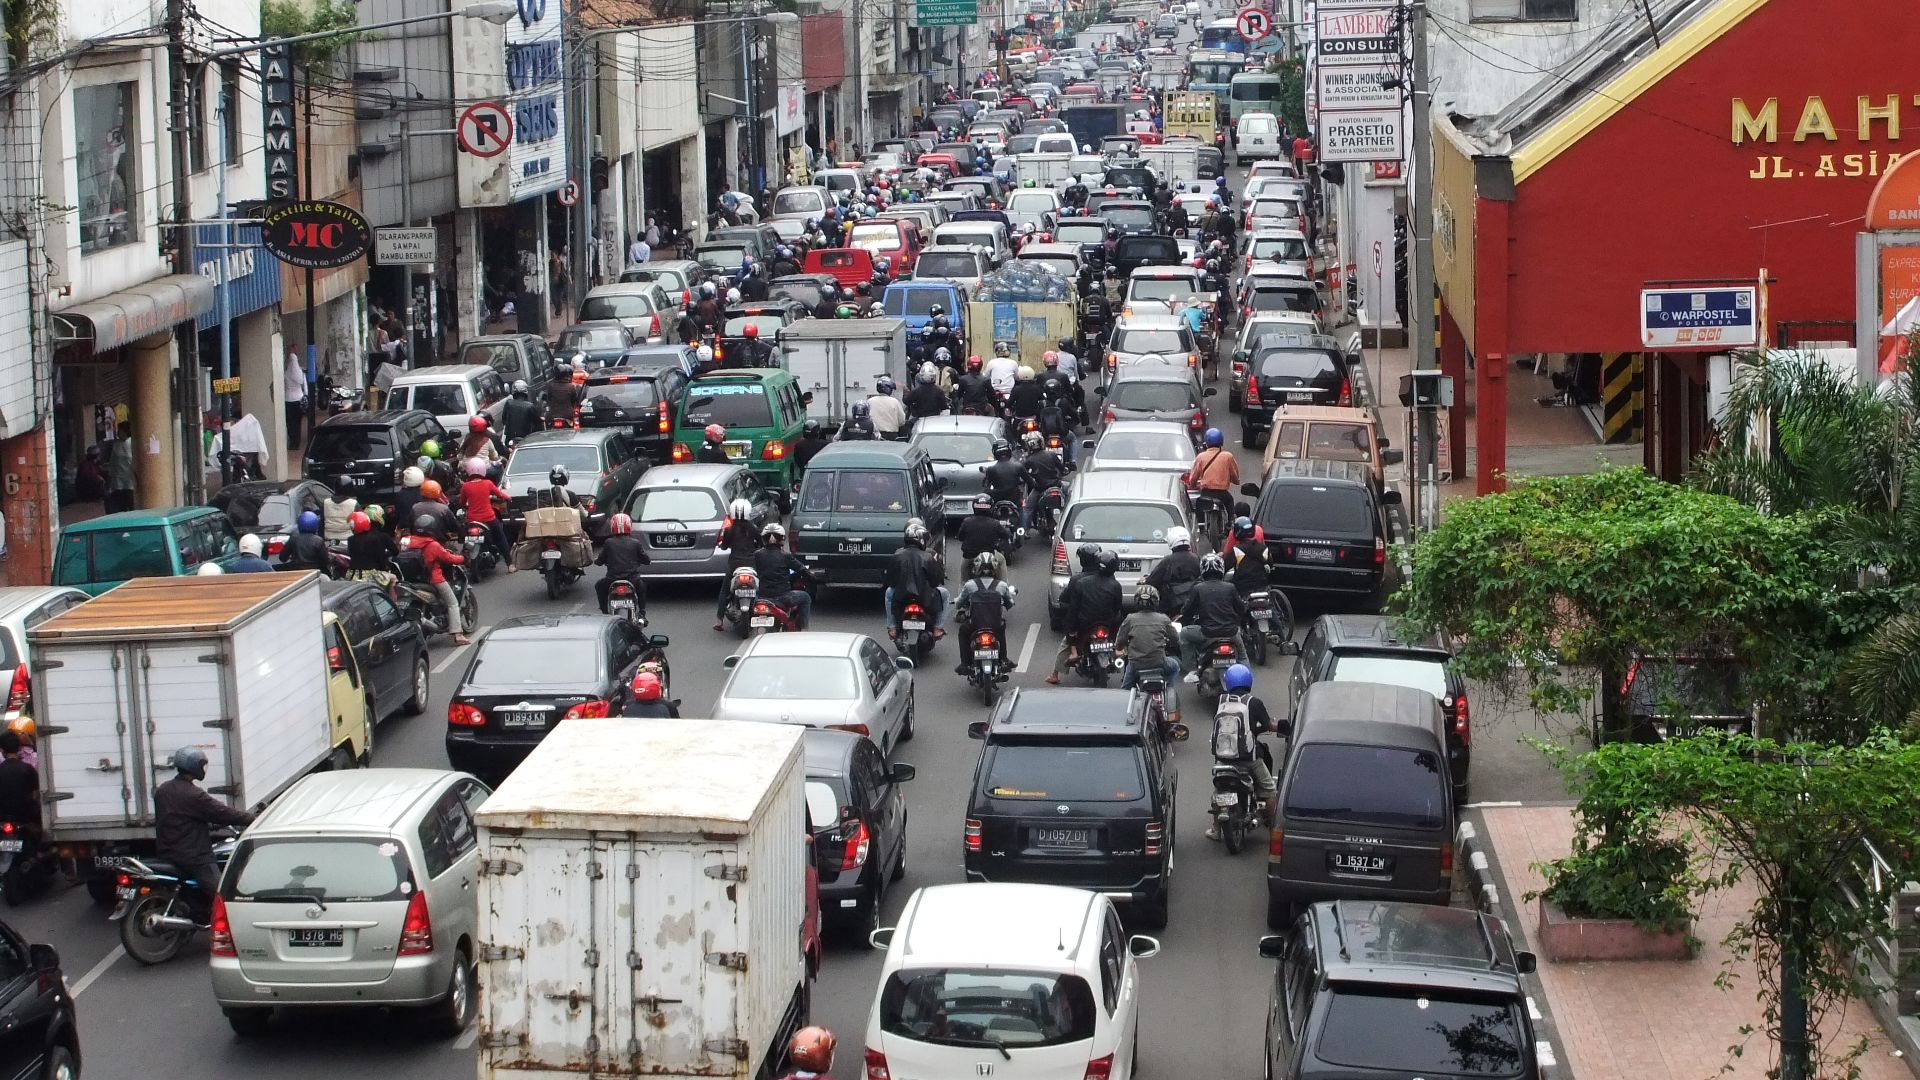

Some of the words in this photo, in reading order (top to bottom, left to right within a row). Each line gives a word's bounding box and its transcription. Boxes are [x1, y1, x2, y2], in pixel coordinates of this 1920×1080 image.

[1325, 74, 1354, 85] WINNER
[1334, 86, 1396, 94] ASSOCIATS
[1328, 124, 1394, 137] PRASETIO
[1328, 138, 1337, 147] &
[1341, 136, 1394, 147] PARTNER
[1750, 156, 1804, 179] JL.
[264, 203, 311, 227] Textile
[327, 204, 366, 231] Tailor
[288, 222, 344, 249] MC
[378, 232, 410, 241] DILARANG
[392, 242, 420, 250] SAMPAI
[380, 252, 402, 260] RAMBU
[1671, 310, 1738, 320] WARPOSTEL
[5, 473, 20, 495] 6
[664, 534, 677, 543] 405
[838, 543, 844, 552] D
[504, 712, 510, 721] D
[512, 712, 532, 721] 1893
[534, 712, 545, 721] KN
[1039, 829, 1046, 840] D
[1049, 829, 1071, 840] 1057
[1335, 854, 1342, 865] D
[1347, 856, 1369, 867] 1537
[1372, 857, 1385, 868] CW
[289, 930, 296, 941] D
[301, 930, 325, 940] 1378
